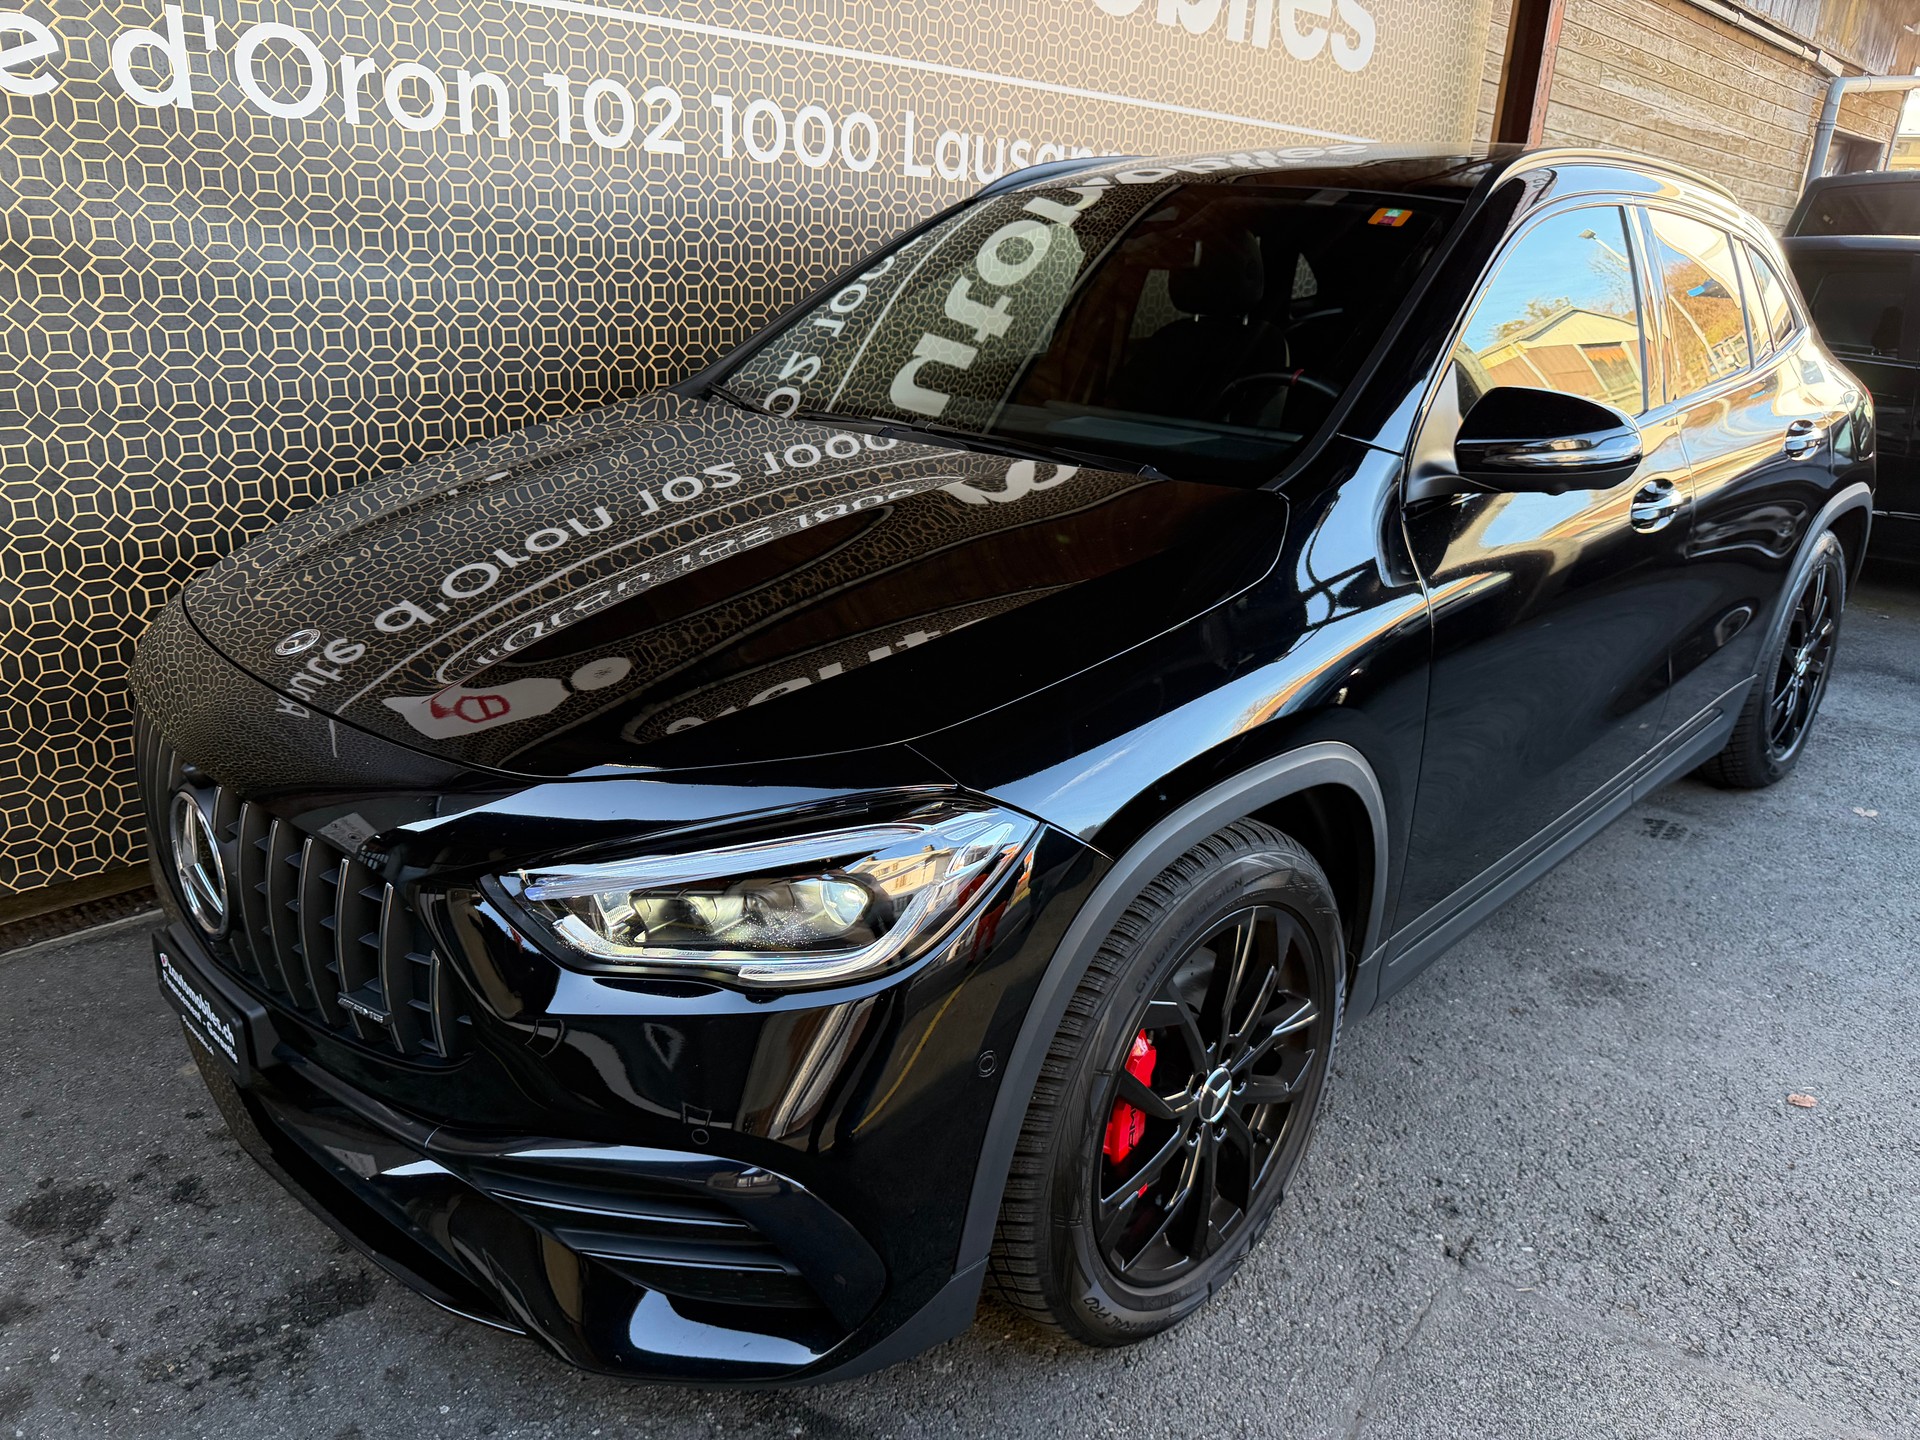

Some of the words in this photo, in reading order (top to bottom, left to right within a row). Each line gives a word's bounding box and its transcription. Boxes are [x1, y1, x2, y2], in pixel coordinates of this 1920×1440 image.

[112, 4, 512, 138] d'Oron
[543, 72, 686, 154] 102
[711, 94, 880, 173] 1000
[903, 110, 1122, 184] Lausa
